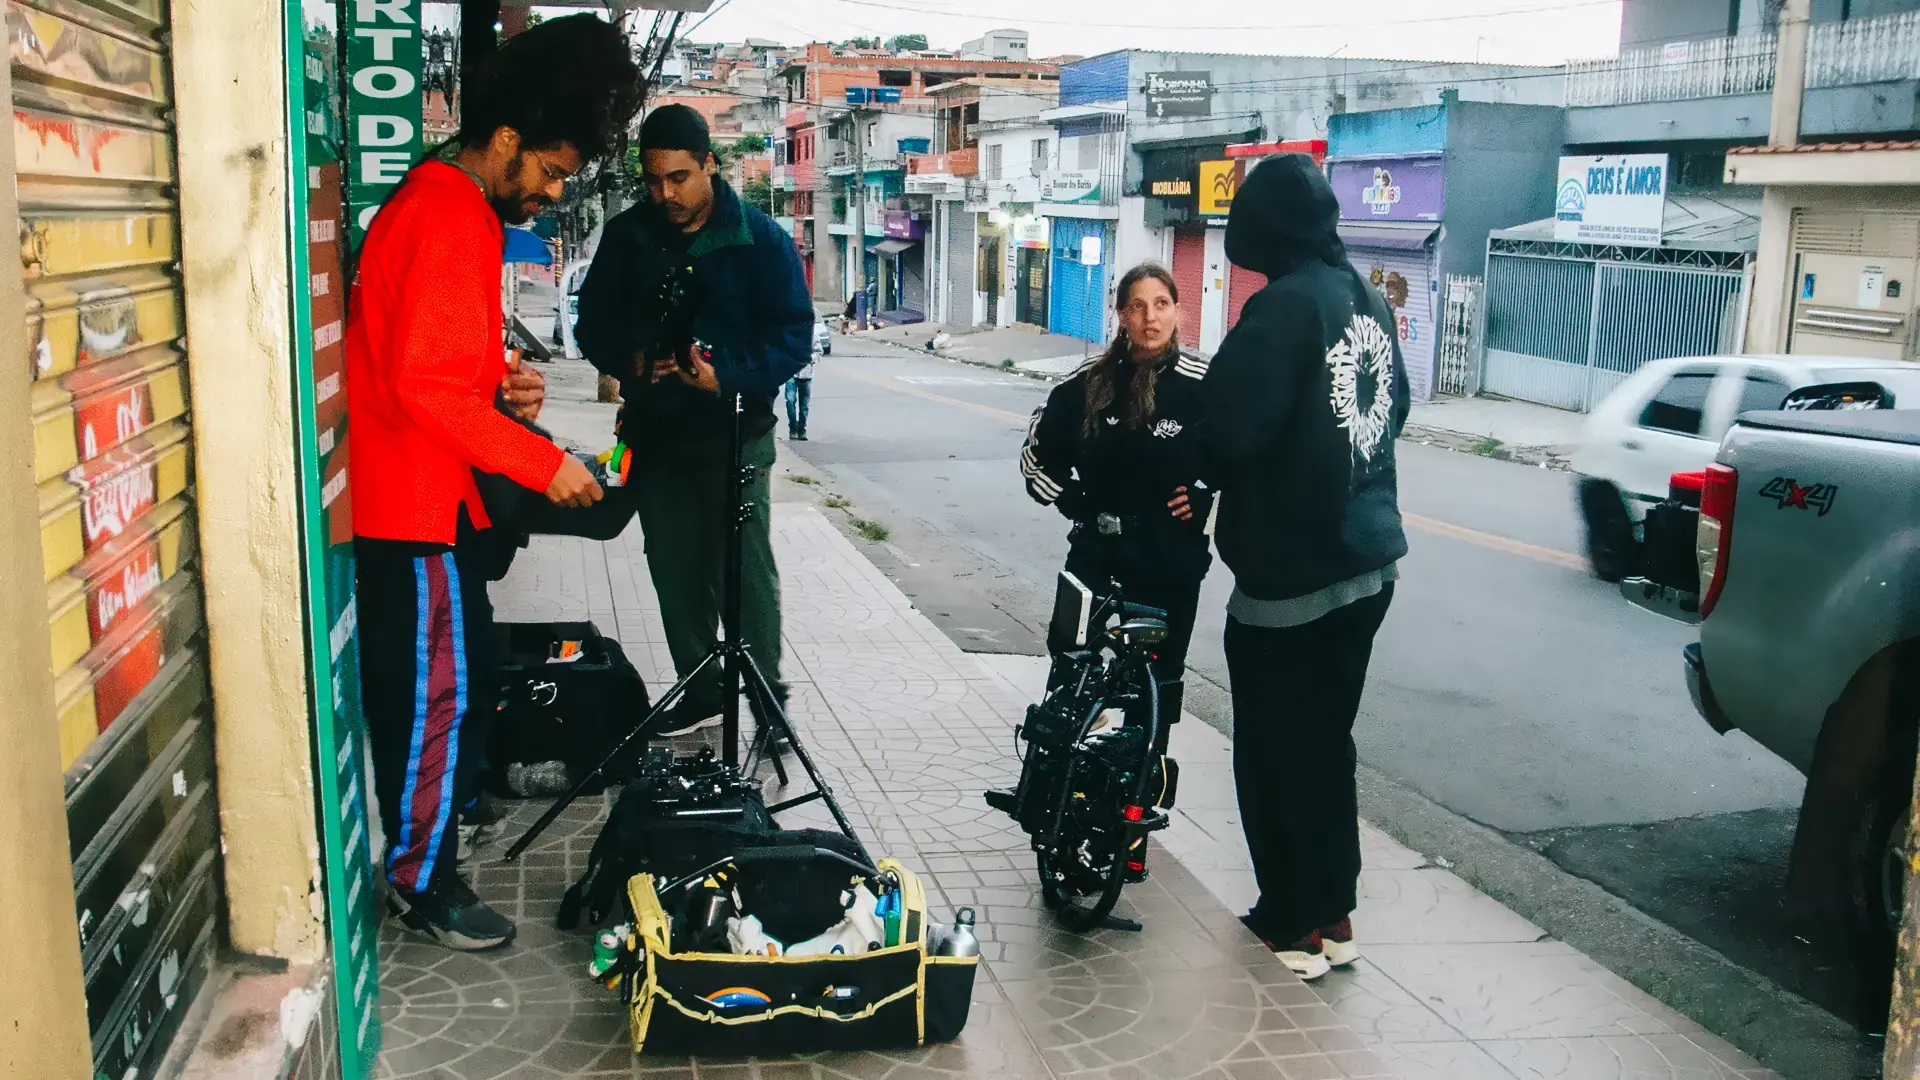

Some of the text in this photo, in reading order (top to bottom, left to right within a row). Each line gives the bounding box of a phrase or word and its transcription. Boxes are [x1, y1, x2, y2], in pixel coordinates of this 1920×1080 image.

[358, 115, 414, 184] DE
[1587, 159, 1662, 195] DEUS É AMOR
